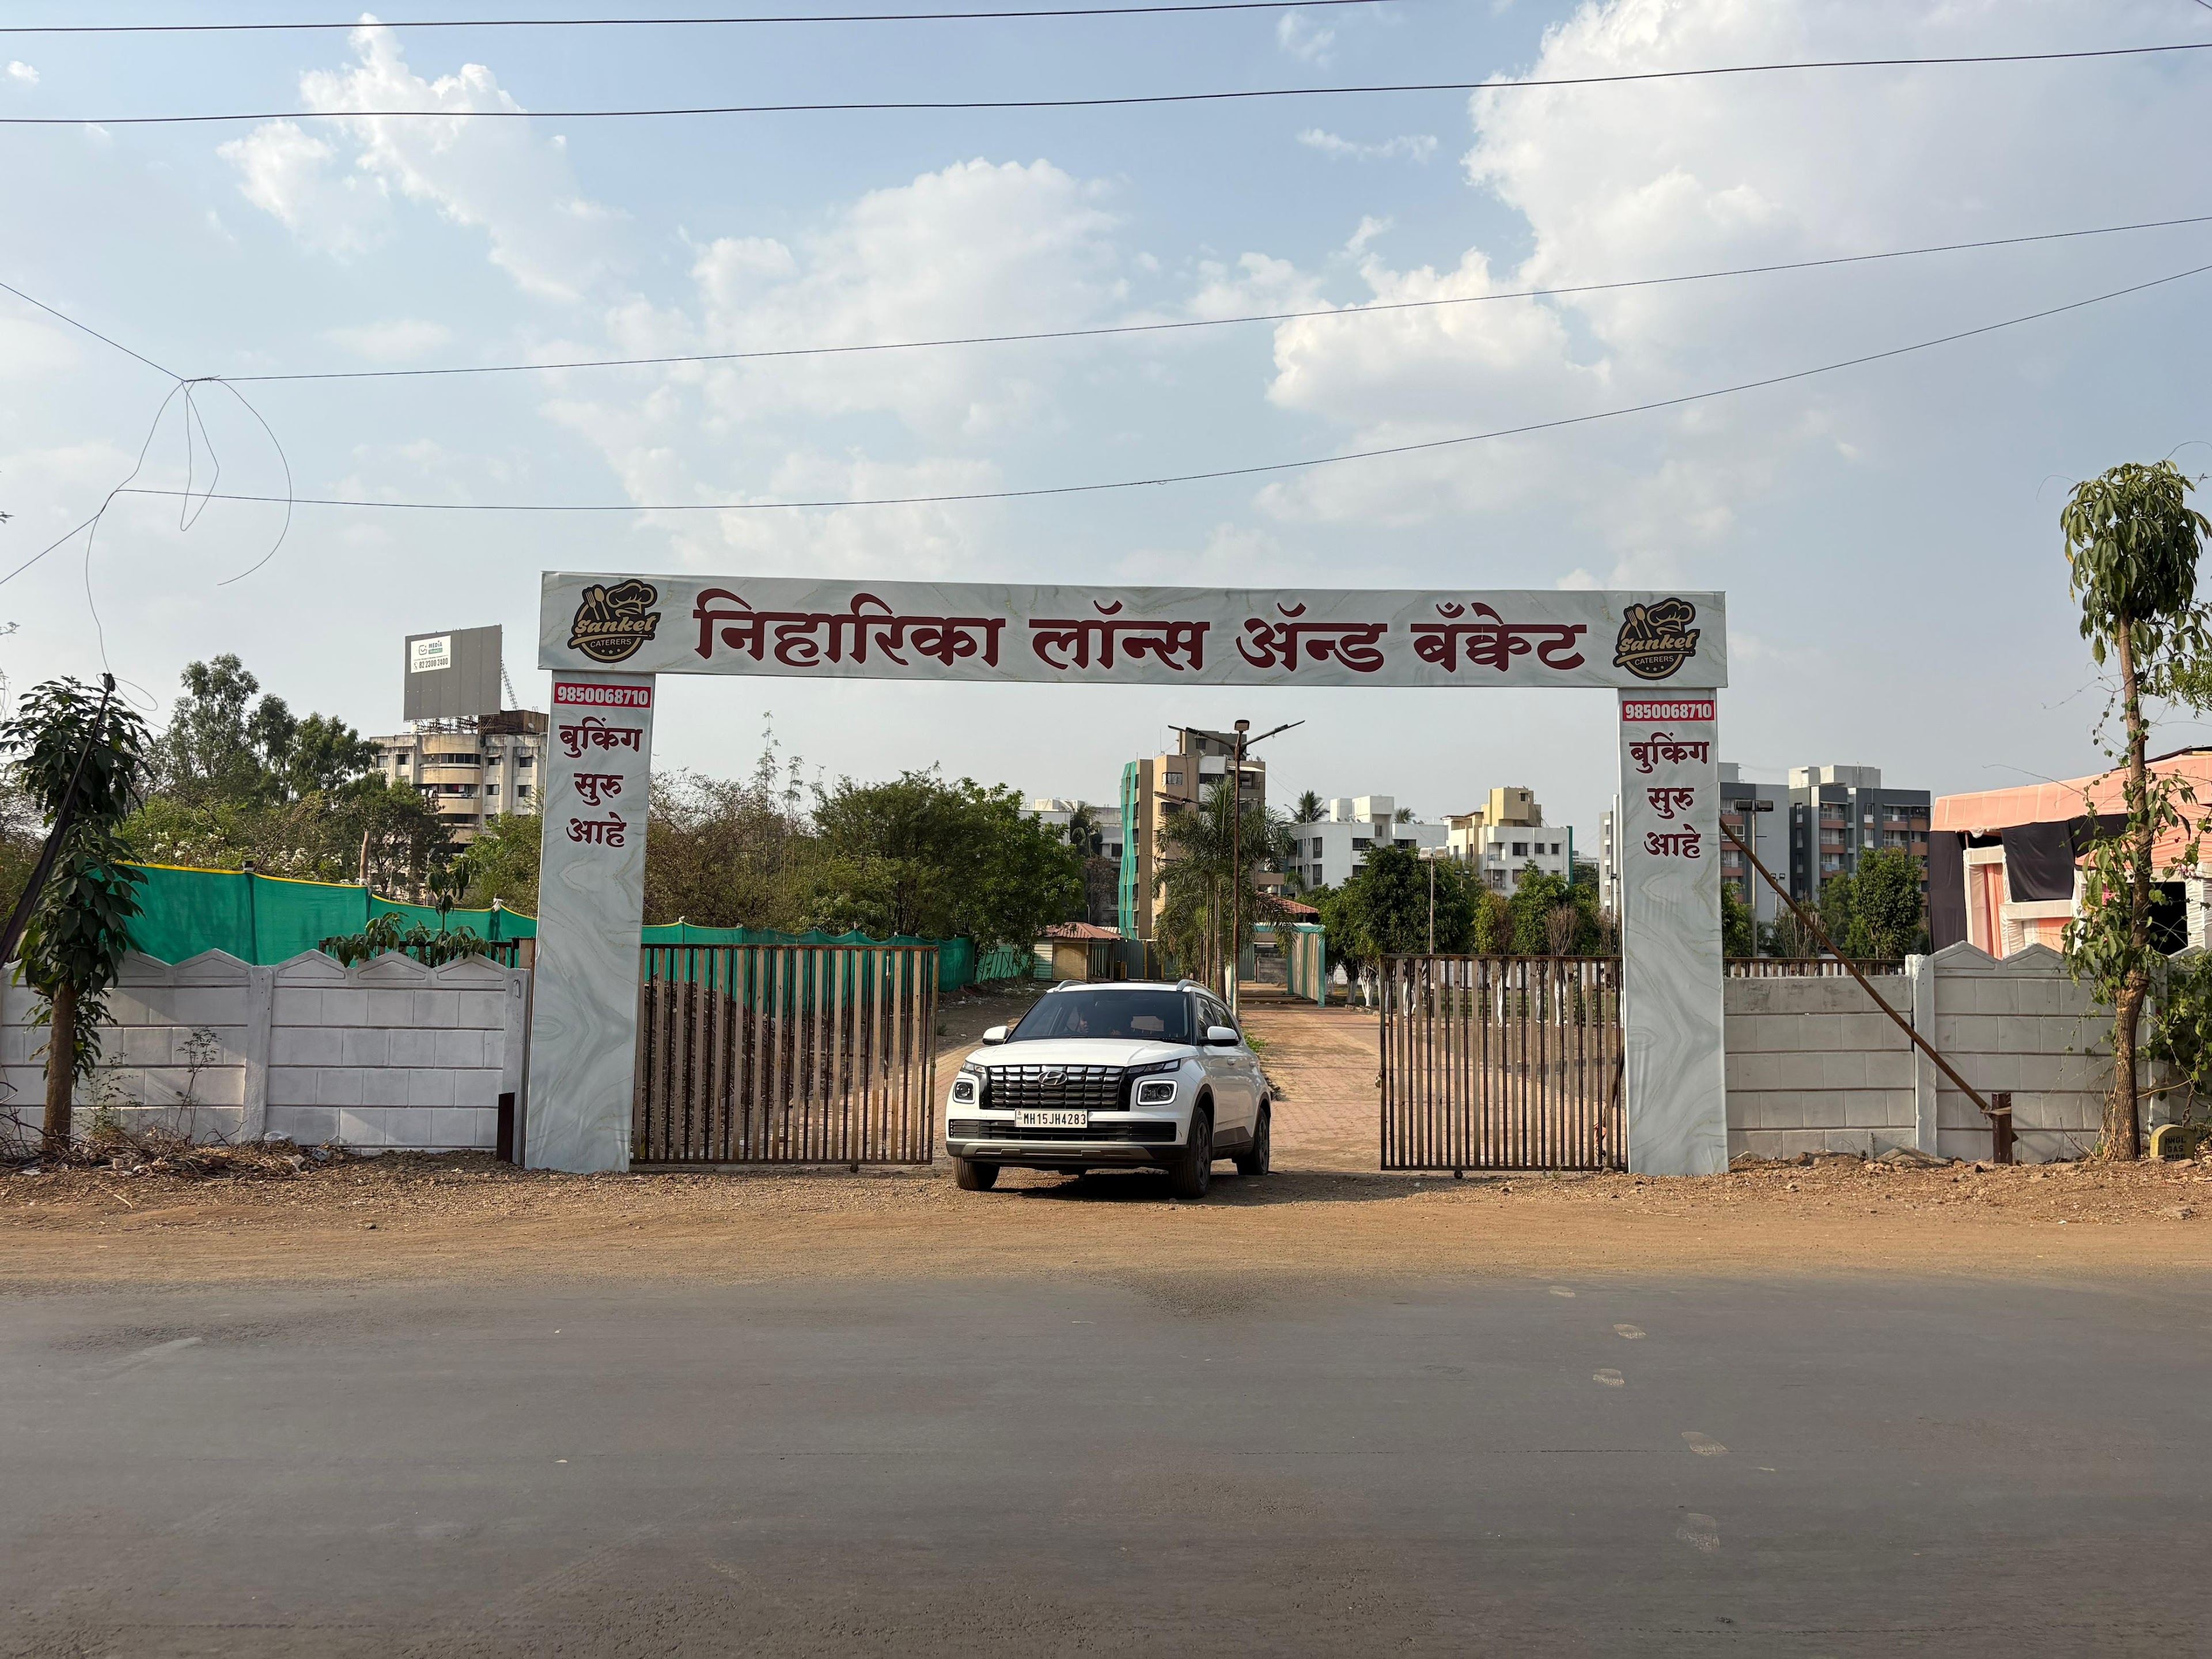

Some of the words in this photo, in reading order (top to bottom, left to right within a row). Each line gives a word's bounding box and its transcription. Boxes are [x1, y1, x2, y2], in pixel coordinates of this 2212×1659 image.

[575, 615, 657, 634] Sanket
[693, 588, 1005, 667] निहारिका
[1029, 600, 1210, 671] लॉन्स
[590, 638, 632, 648] CATERERS
[1618, 632, 1697, 652] Sanket
[419, 661, 425, 669] 82
[425, 660, 437, 668] 2300
[437, 657, 448, 666] 2400
[1634, 656, 1675, 665] CATERERS
[557, 686, 649, 705] 9850068710
[1625, 703, 1712, 719] 9850068710
[559, 716, 643, 758] बुकिंग
[1629, 732, 1710, 774] बुकिंग
[574, 772, 624, 806] सुरु
[1647, 787, 1695, 820] सुरु
[566, 811, 627, 847] आहे
[1644, 823, 1701, 858] आहे
[1024, 1113, 1086, 1124] MH15JH4283
